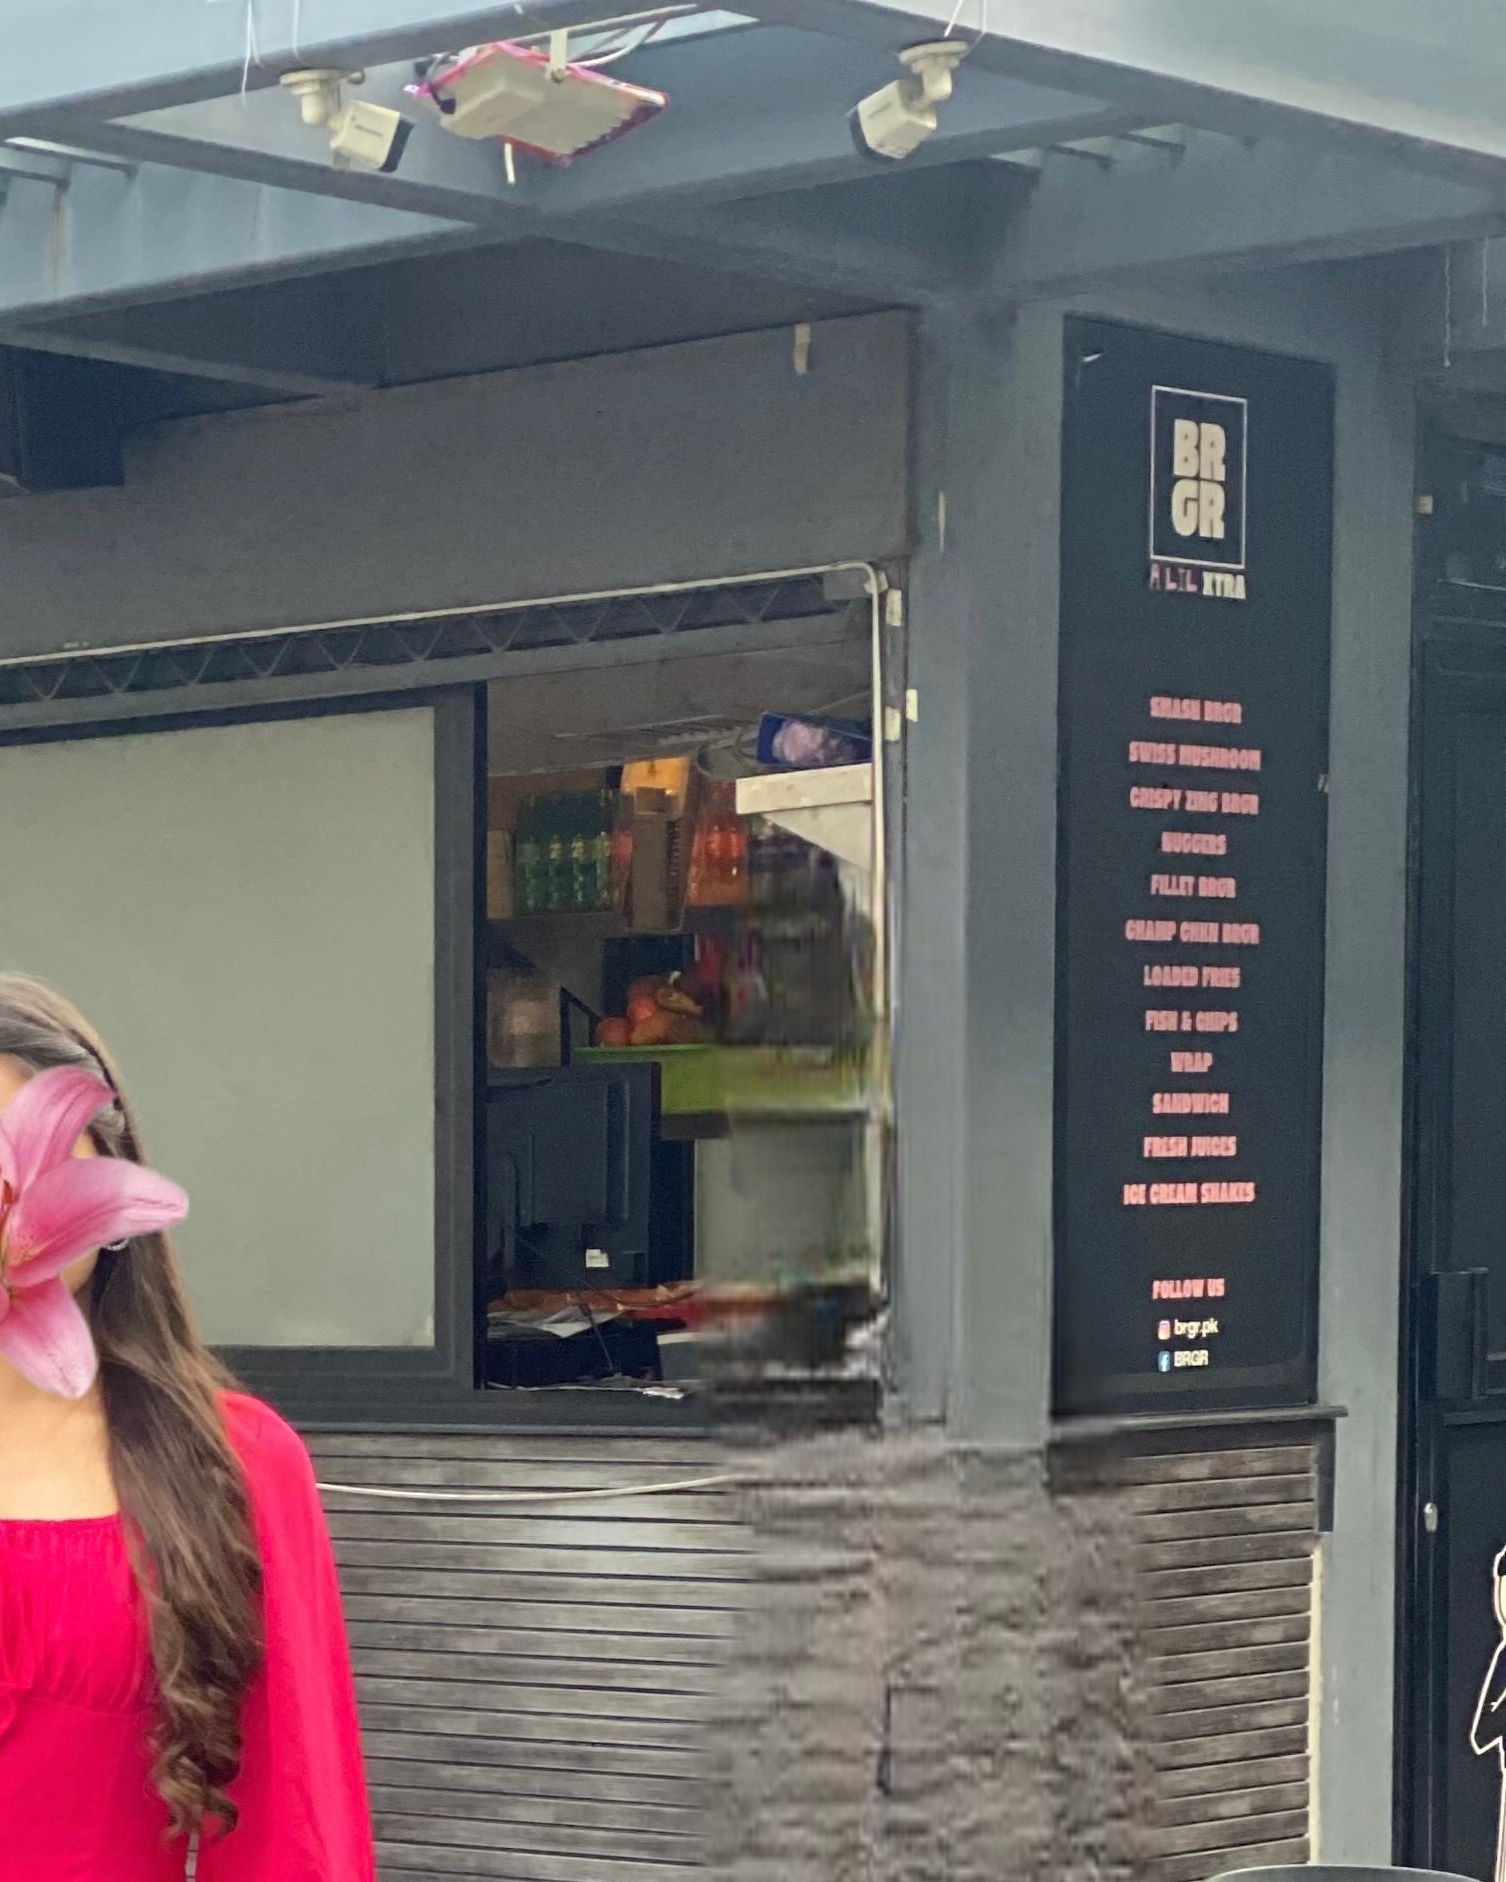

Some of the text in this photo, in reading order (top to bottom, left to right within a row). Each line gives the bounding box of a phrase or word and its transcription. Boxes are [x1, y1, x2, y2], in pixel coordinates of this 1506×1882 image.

[1129, 741, 1261, 770] SWISS MUSHROOM
[1130, 786, 1182, 810] CRISPY
[1161, 832, 1226, 855] NUGGETS
[1150, 874, 1194, 896] FILLET
[1143, 964, 1240, 988] LOADED FRIES
[1146, 1010, 1238, 1032] FISH & CHIPS
[1170, 1051, 1213, 1073] WRAP
[1152, 1092, 1230, 1114] SANDWICH
[1143, 1135, 1237, 1158] FRESH JUICES
[1122, 1181, 1255, 1205] ICE CREAM SHAKES
[1152, 1278, 1225, 1299] FOLLOW US
[1174, 1317, 1219, 1339] brgr.pk
[1174, 1349, 1209, 1367] BRGR
